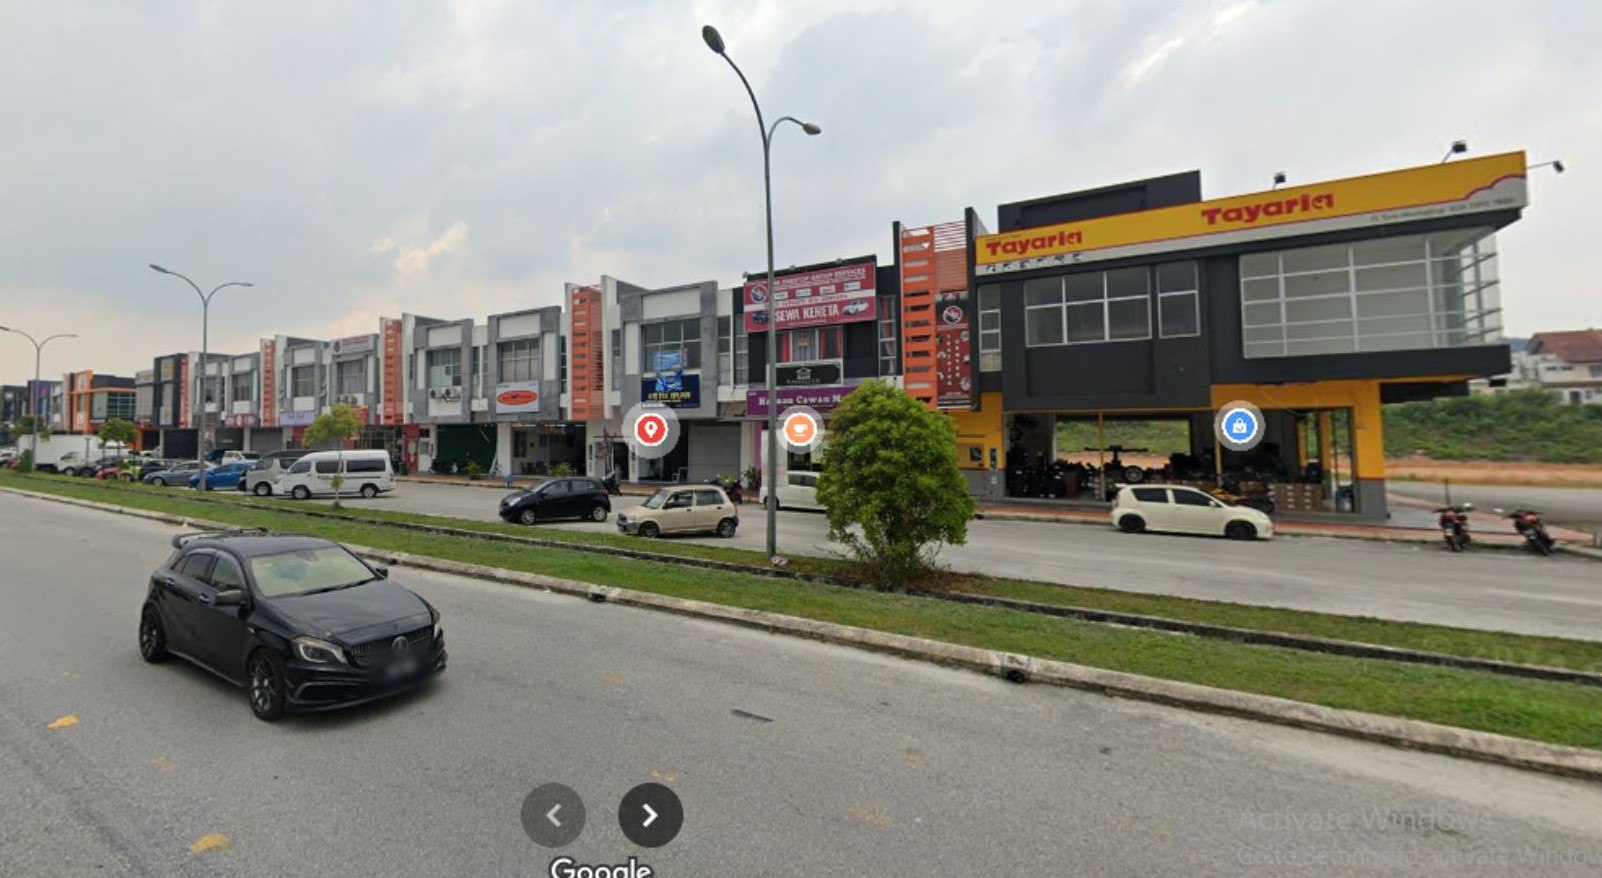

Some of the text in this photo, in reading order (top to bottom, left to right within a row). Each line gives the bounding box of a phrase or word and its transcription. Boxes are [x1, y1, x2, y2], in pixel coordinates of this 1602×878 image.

[1201, 193, 1334, 225] Tayaria
[985, 230, 1083, 256] Tayaria
[775, 303, 839, 322] SEWA KERETA
